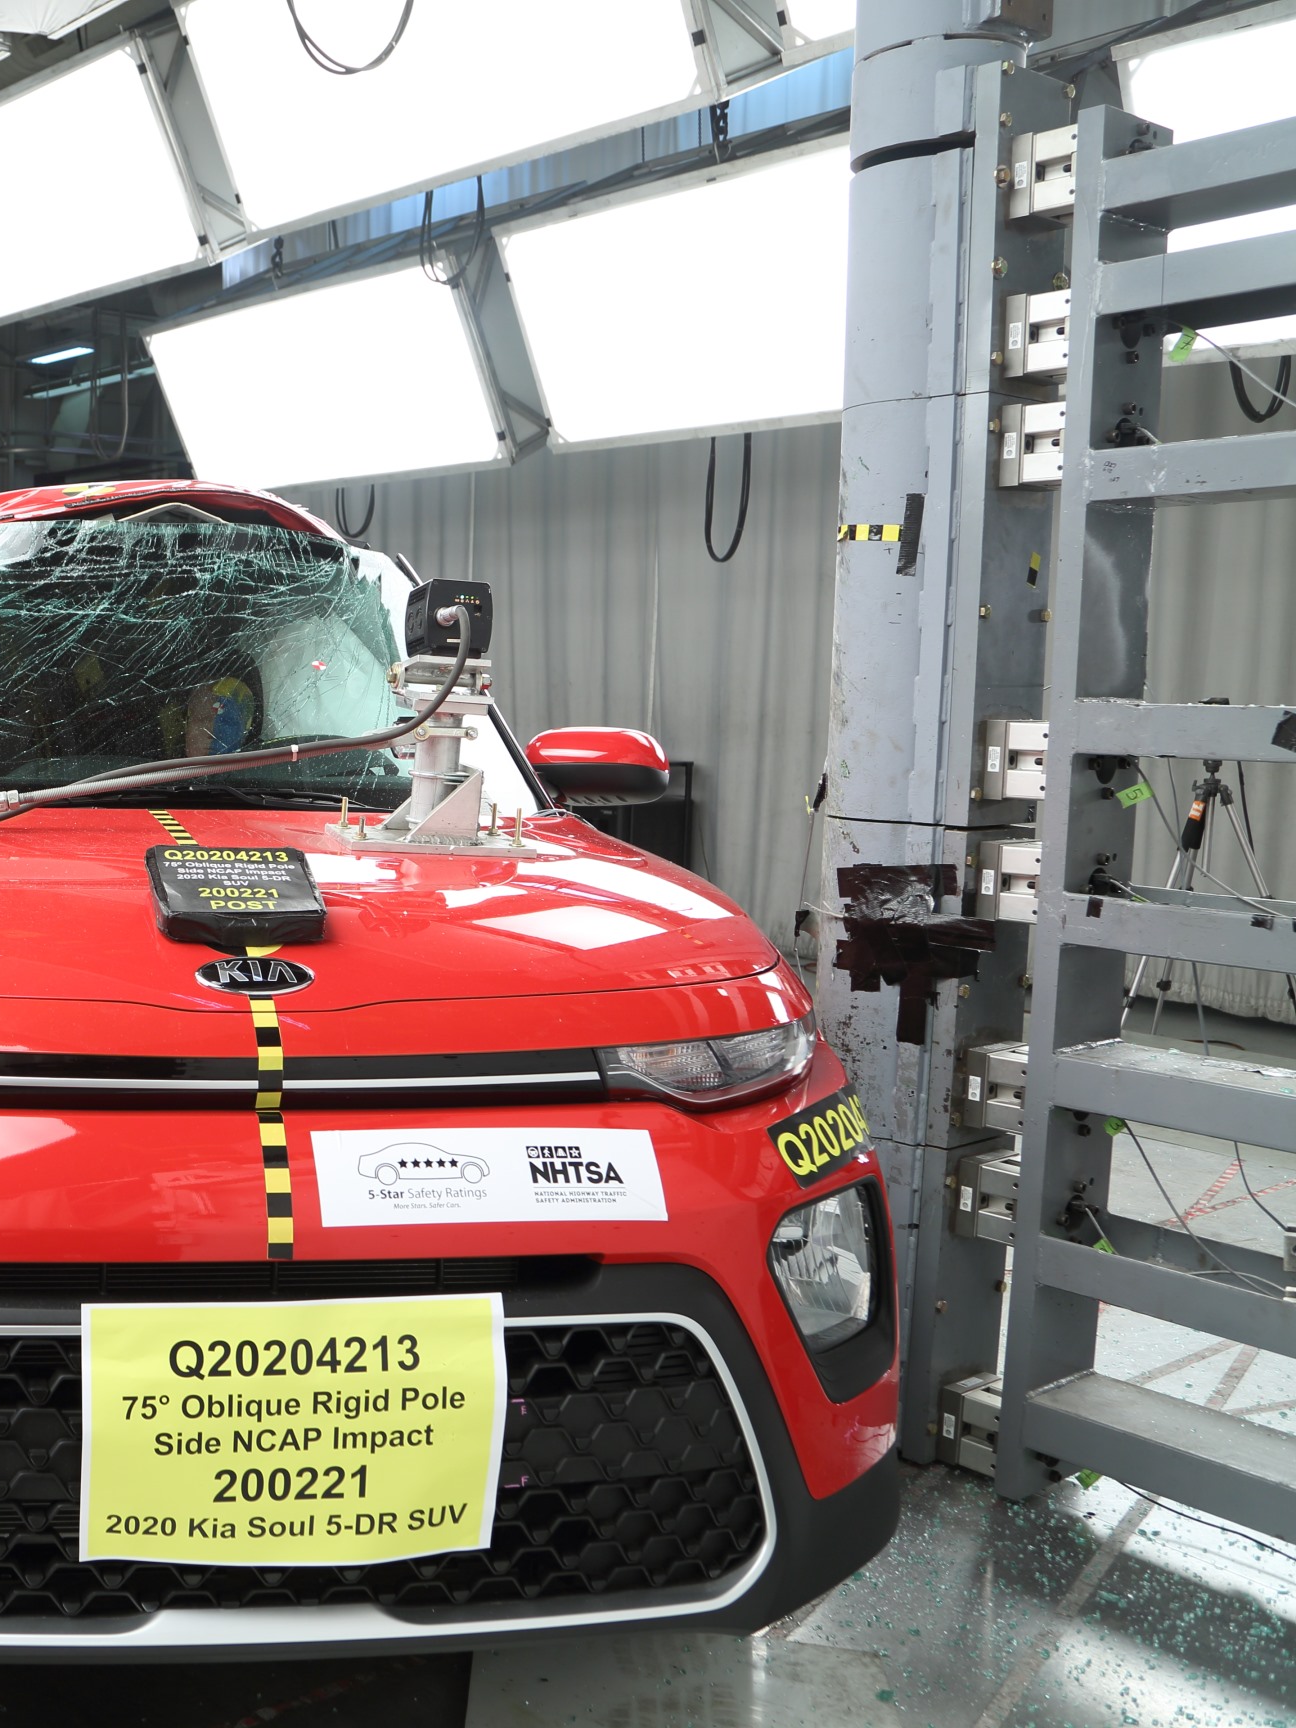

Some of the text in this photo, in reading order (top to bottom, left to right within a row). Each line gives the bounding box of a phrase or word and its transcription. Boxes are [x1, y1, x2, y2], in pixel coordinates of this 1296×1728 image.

[164, 850, 289, 862] Q20204213
[185, 861, 232, 869] Oblique
[234, 862, 266, 870] Rigid
[245, 868, 287, 876] Impact
[198, 887, 280, 899] 200221
[210, 900, 278, 910] POST
[215, 960, 298, 983] KIA
[529, 1161, 624, 1184] NHTSA
[368, 1187, 488, 1201] 5-Star Safety Ratings
[168, 1334, 420, 1380] Q20204213
[122, 1386, 466, 1422] 75° Oblique Rigid Pole
[154, 1424, 434, 1456] Side NCAP Impact
[212, 1465, 367, 1503] 200221
[105, 1503, 468, 1539] 2020 Kia Soul 5-DR SUV
